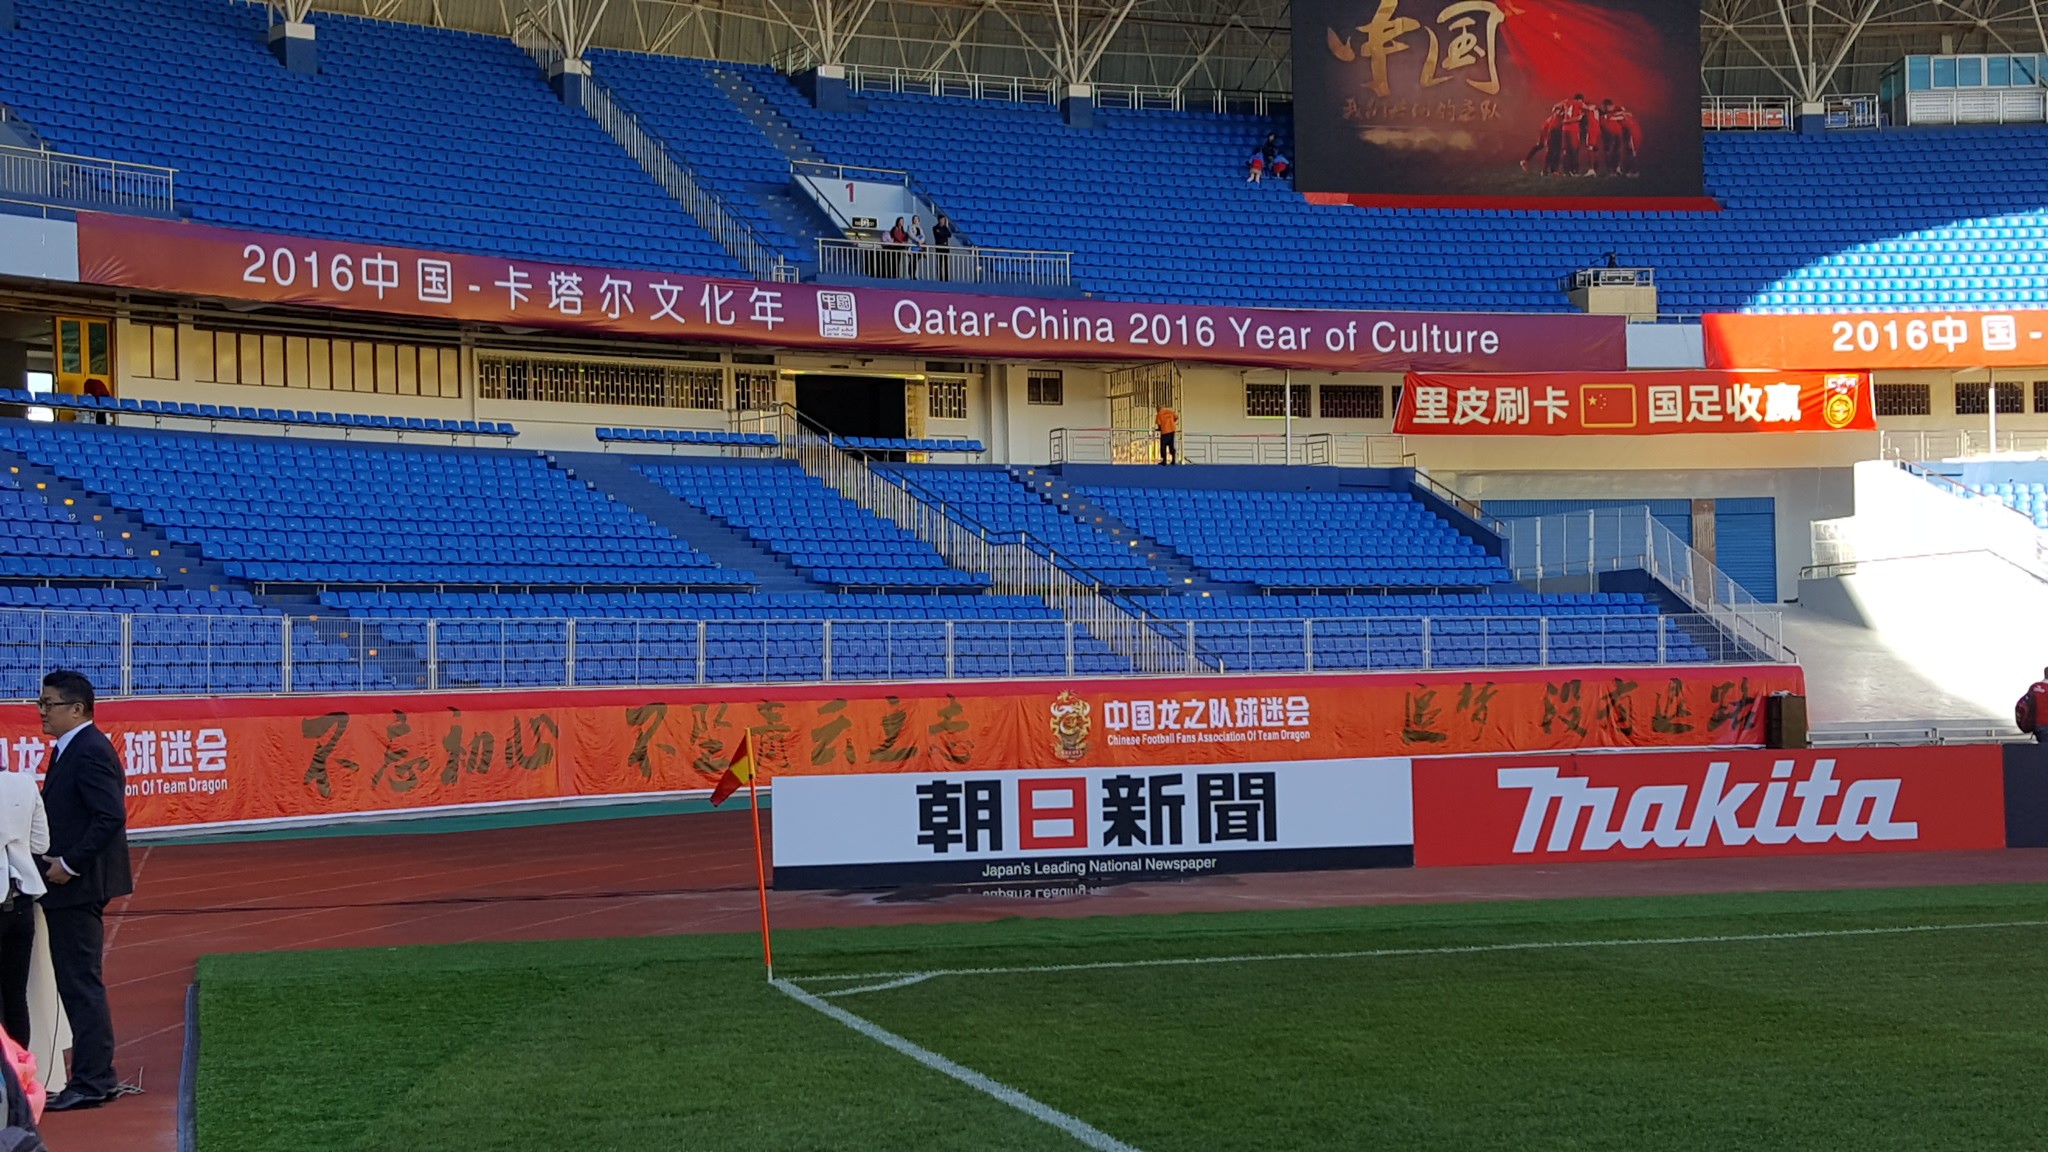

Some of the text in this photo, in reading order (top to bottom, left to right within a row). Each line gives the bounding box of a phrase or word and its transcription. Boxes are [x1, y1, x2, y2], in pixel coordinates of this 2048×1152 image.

[1328, 0, 1504, 96] 中国
[845, 182, 855, 203] 1
[893, 299, 1500, 354] Qatar-China 2016 Year of Culture
[1412, 383, 1802, 425] 里皮刷卡 国足收赢
[1104, 696, 1311, 731] 中国龙之队球迷会
[1107, 728, 1311, 746] Chinese Football Fans Association Of Team Dragon
[142, 781, 155, 795] Of
[158, 778, 187, 793] Team
[189, 777, 228, 795] Dragon
[916, 772, 1278, 853] 朝日新聞
[982, 857, 1217, 878] Japan's Leading National Newspaper
